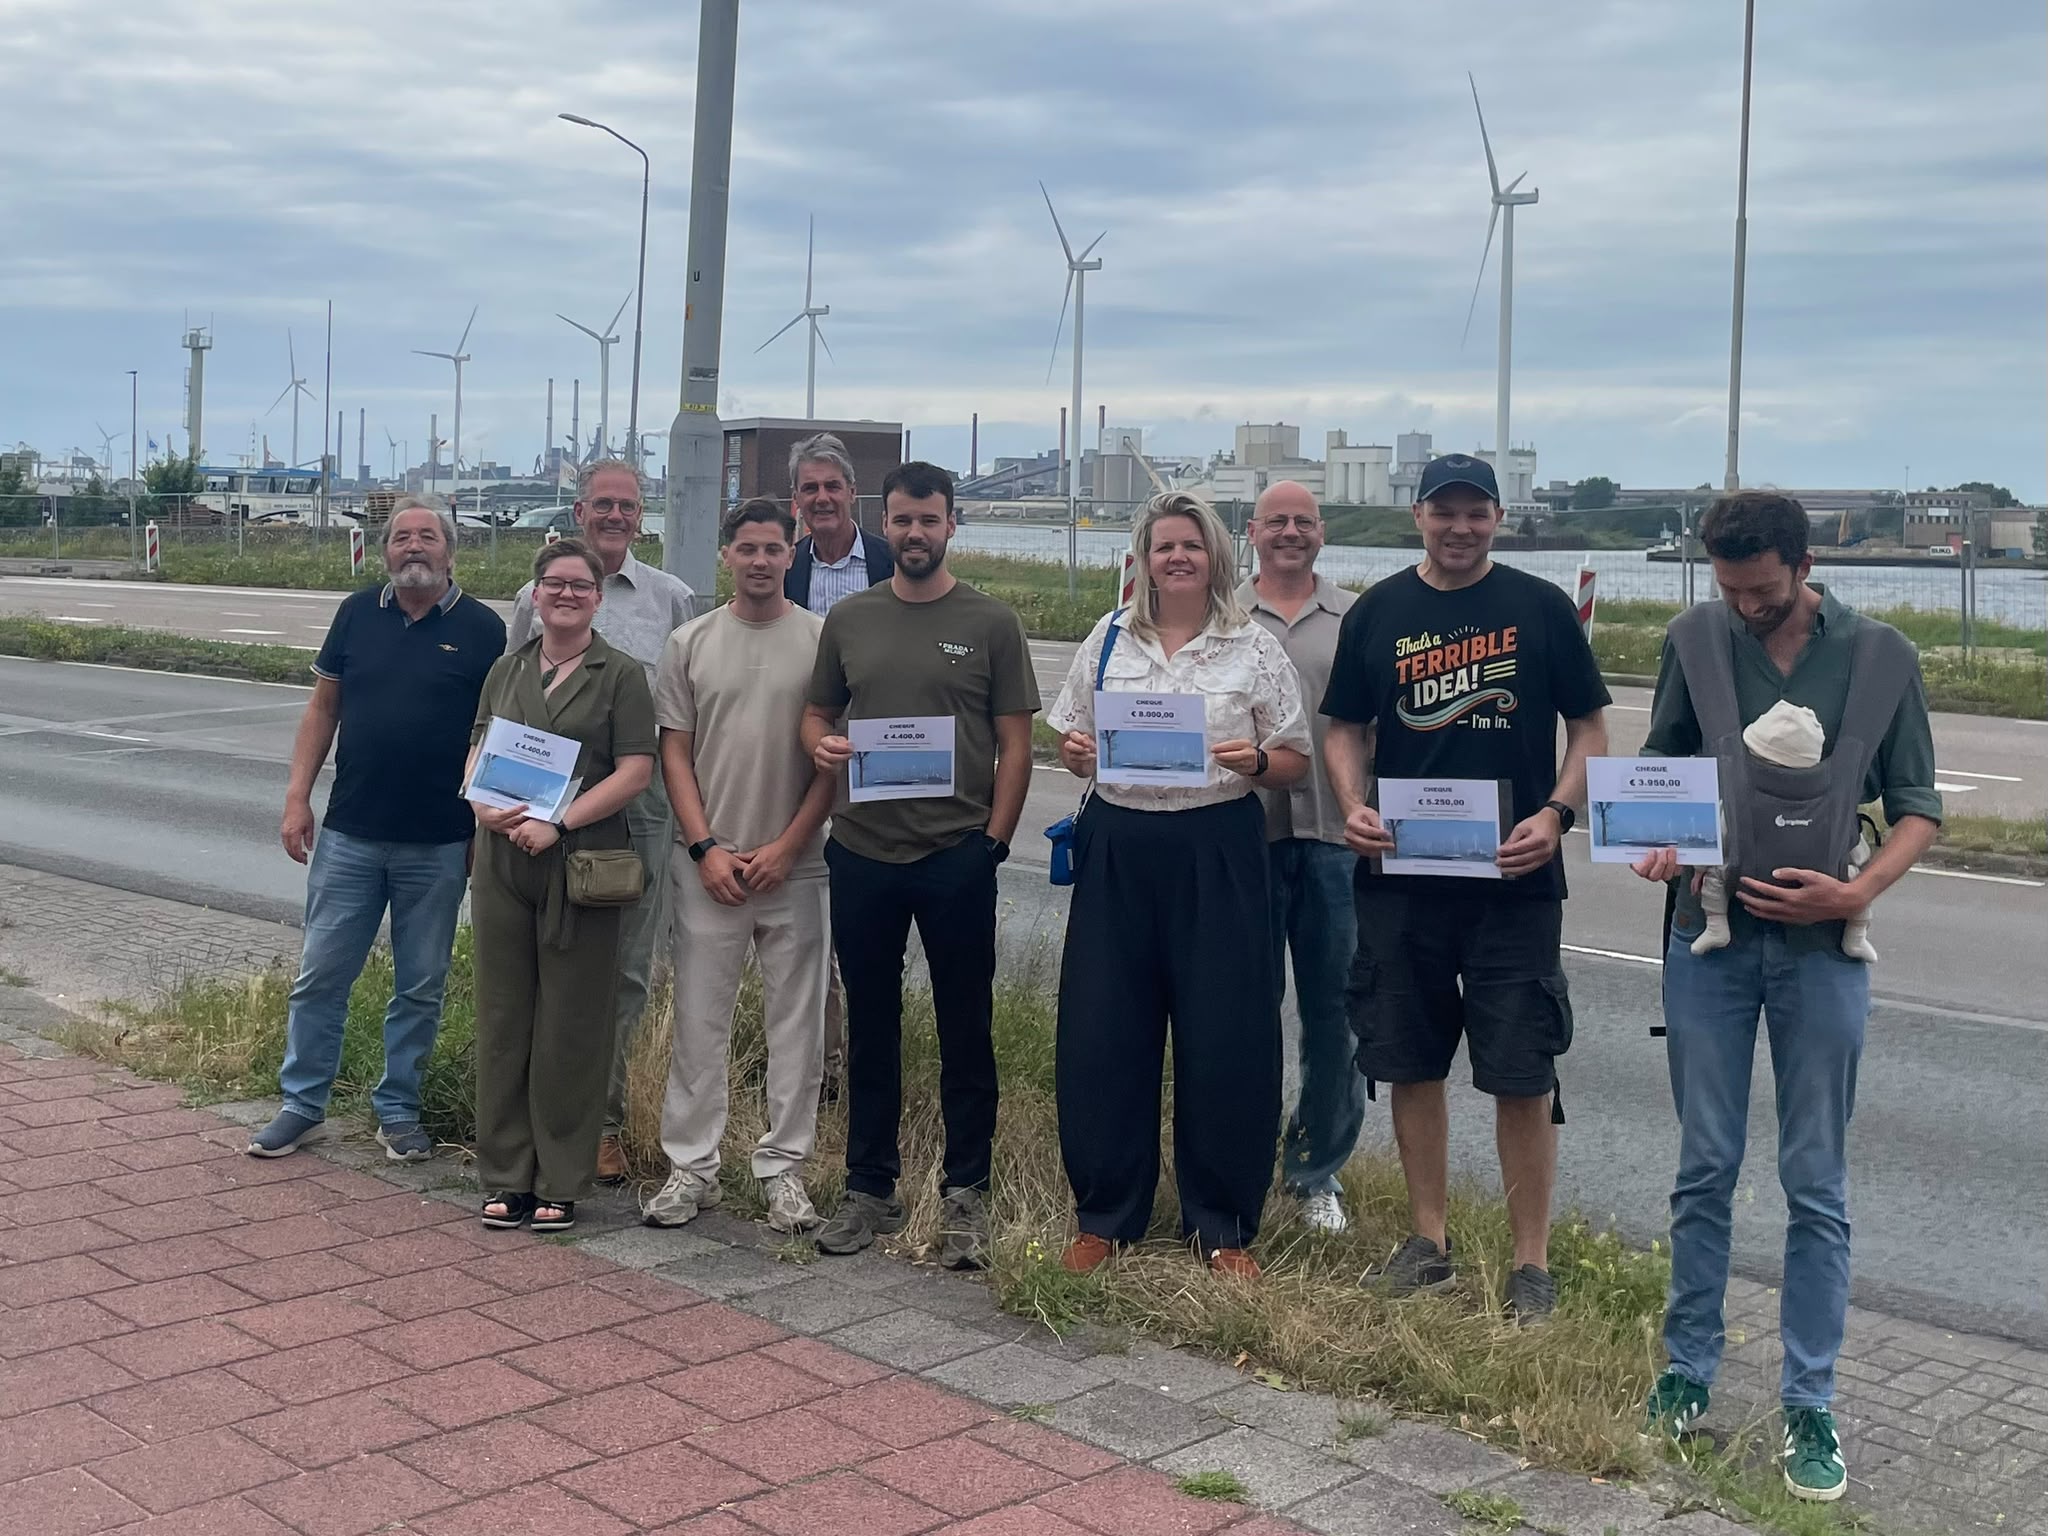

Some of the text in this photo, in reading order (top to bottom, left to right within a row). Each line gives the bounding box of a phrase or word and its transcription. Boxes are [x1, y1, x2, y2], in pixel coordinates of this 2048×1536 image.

[943, 642, 969, 653] PRADA
[1396, 631, 1442, 657] That's a
[1395, 626, 1518, 685] TERRIBLE
[1413, 664, 1480, 709] IDEA!
[1138, 710, 1175, 719] 8.000,00
[1472, 713, 1491, 729] I'm
[1494, 714, 1512, 729] in.
[523, 733, 546, 743] CHEQUE
[520, 743, 551, 758] 4.400,00
[1638, 779, 1681, 788] 3.950,00
[1426, 798, 1465, 806] 5.250,00
